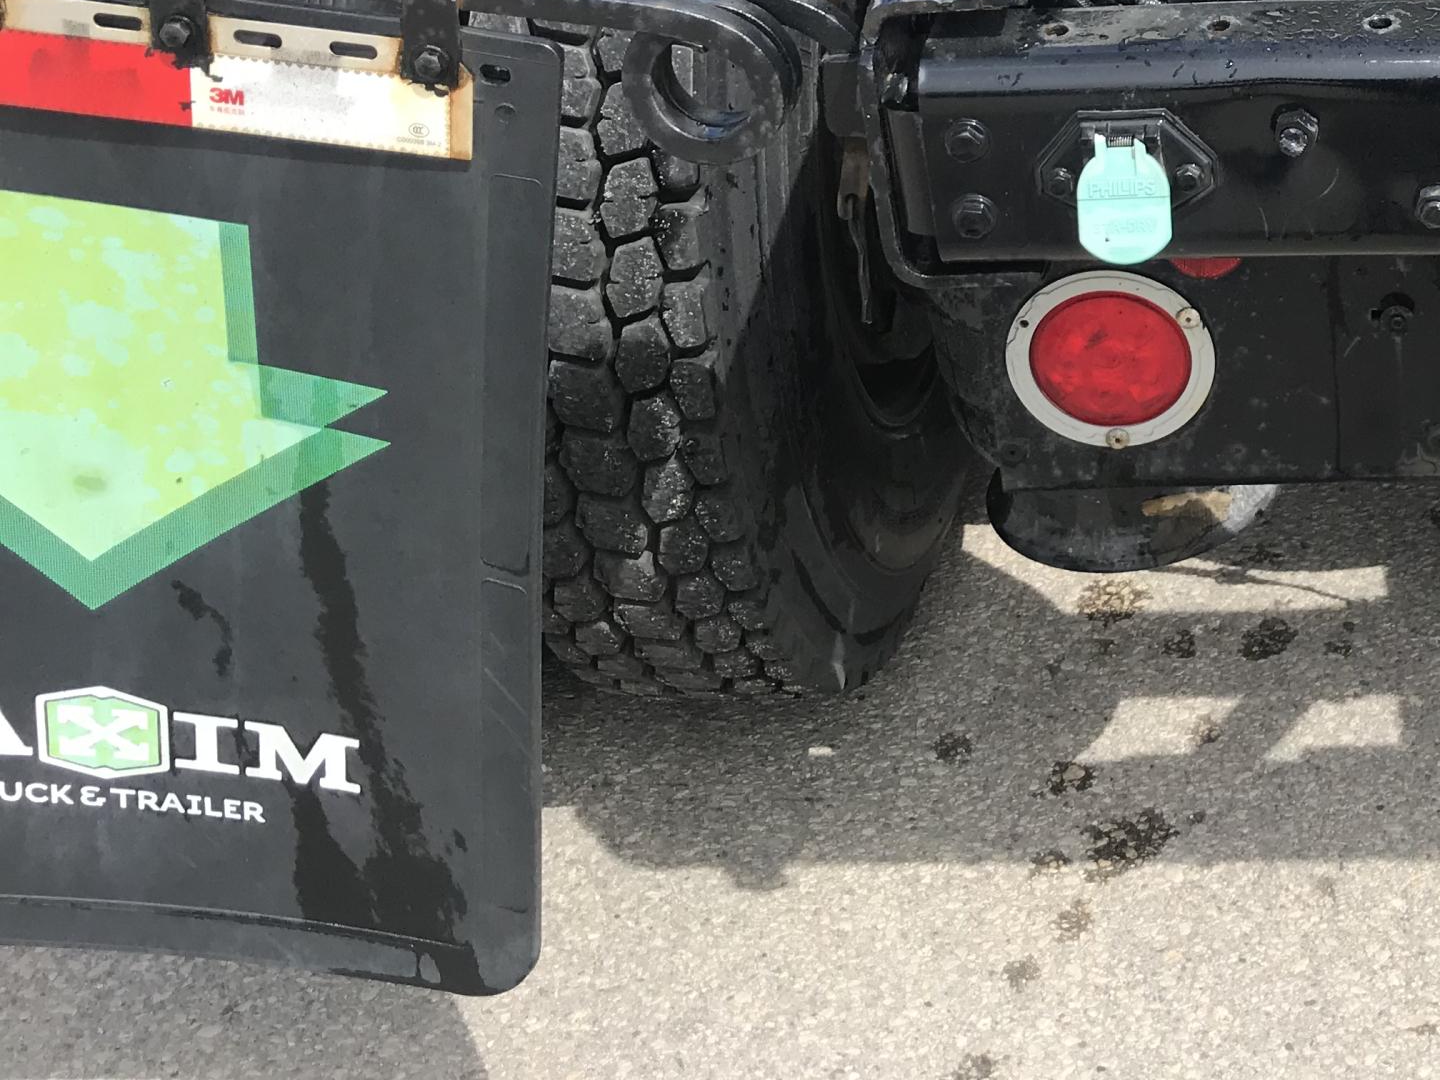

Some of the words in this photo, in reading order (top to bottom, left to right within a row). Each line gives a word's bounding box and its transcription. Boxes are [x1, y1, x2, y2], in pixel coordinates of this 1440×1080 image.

[209, 87, 245, 106] 3M
[80, 785, 107, 807] &
[109, 787, 266, 823] TRAILER
